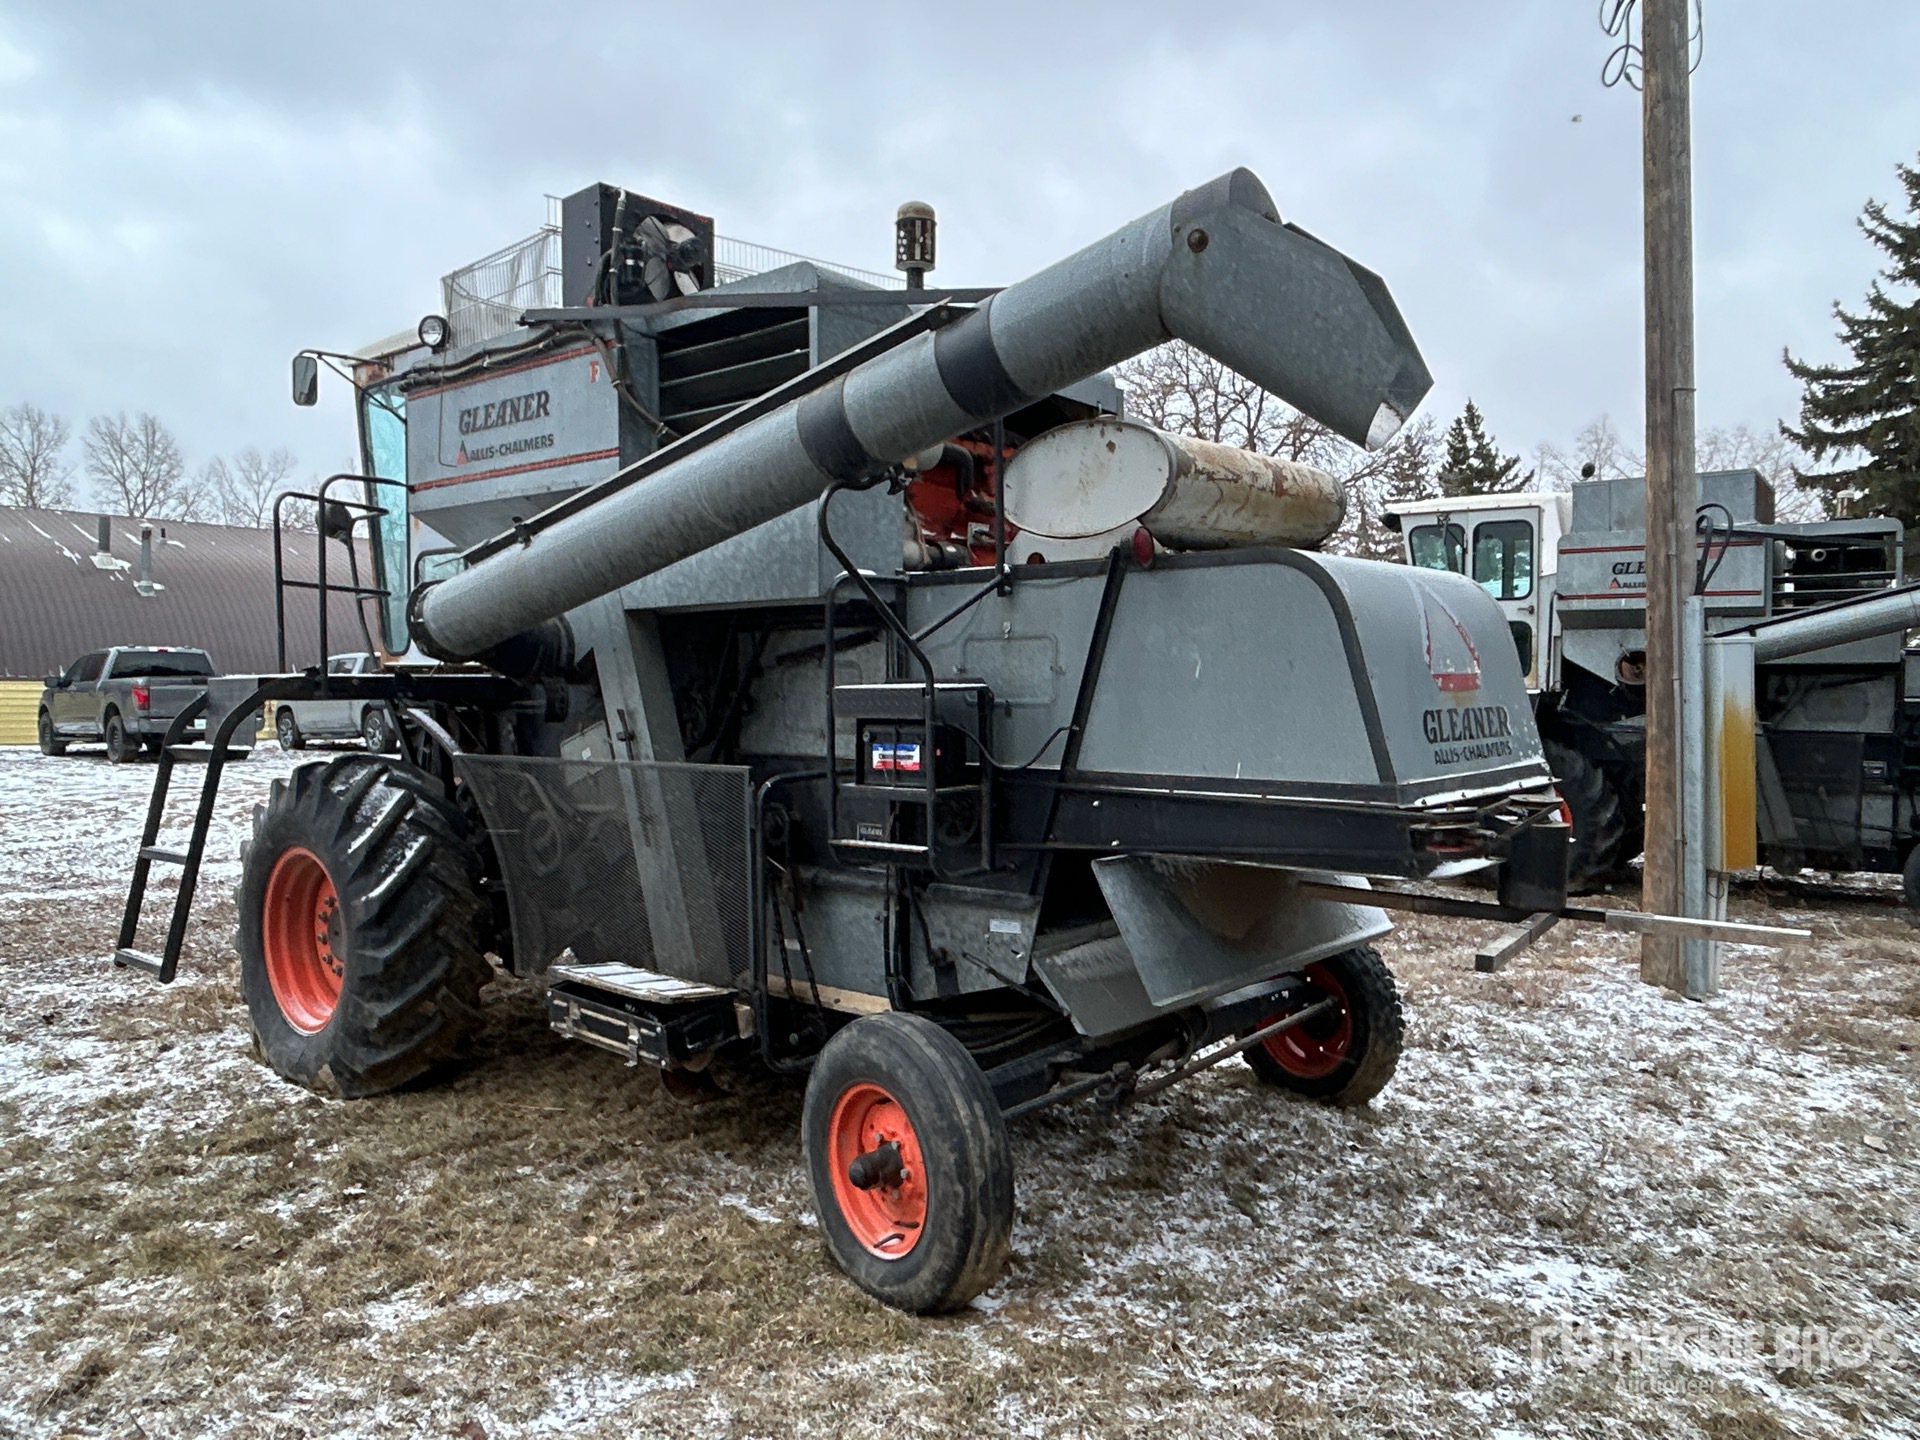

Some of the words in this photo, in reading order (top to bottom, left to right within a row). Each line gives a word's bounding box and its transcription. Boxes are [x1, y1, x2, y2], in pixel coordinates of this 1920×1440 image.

[458, 390, 550, 436] GLEANER
[1611, 560, 1647, 576] GLE
[1422, 705, 1512, 745] GLEANER
[1434, 741, 1513, 765] ALLIS-CHALMERS
